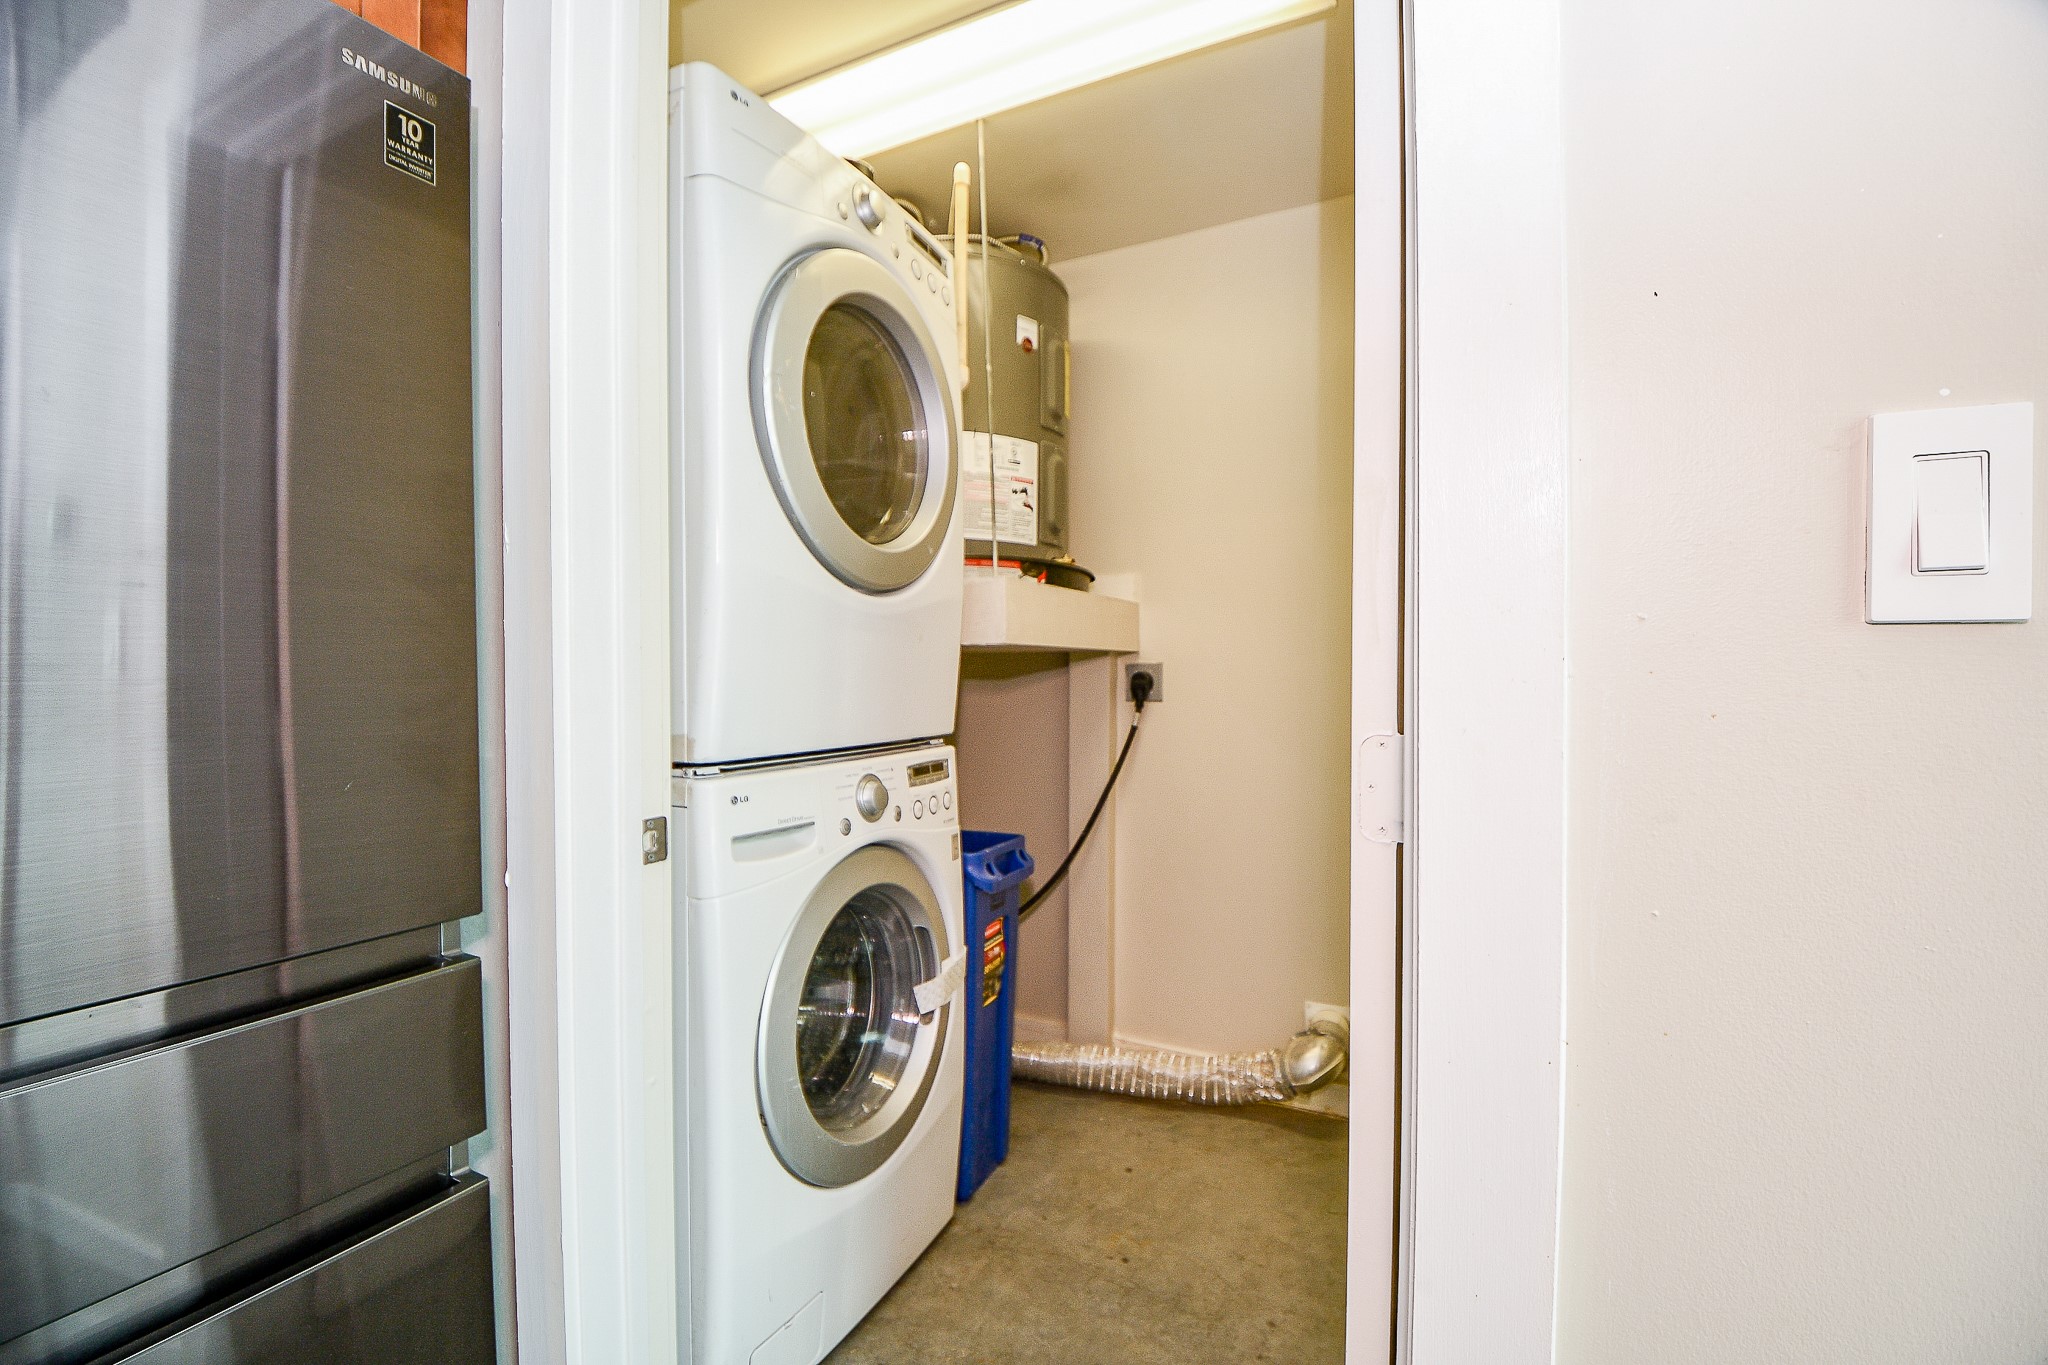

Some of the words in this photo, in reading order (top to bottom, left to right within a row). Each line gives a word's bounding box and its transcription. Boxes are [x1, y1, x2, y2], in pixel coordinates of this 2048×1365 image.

[341, 47, 437, 107] SAMSUNG
[398, 113, 422, 142] 10
[387, 138, 433, 165] WARRANTY
[402, 135, 419, 150] YEAR
